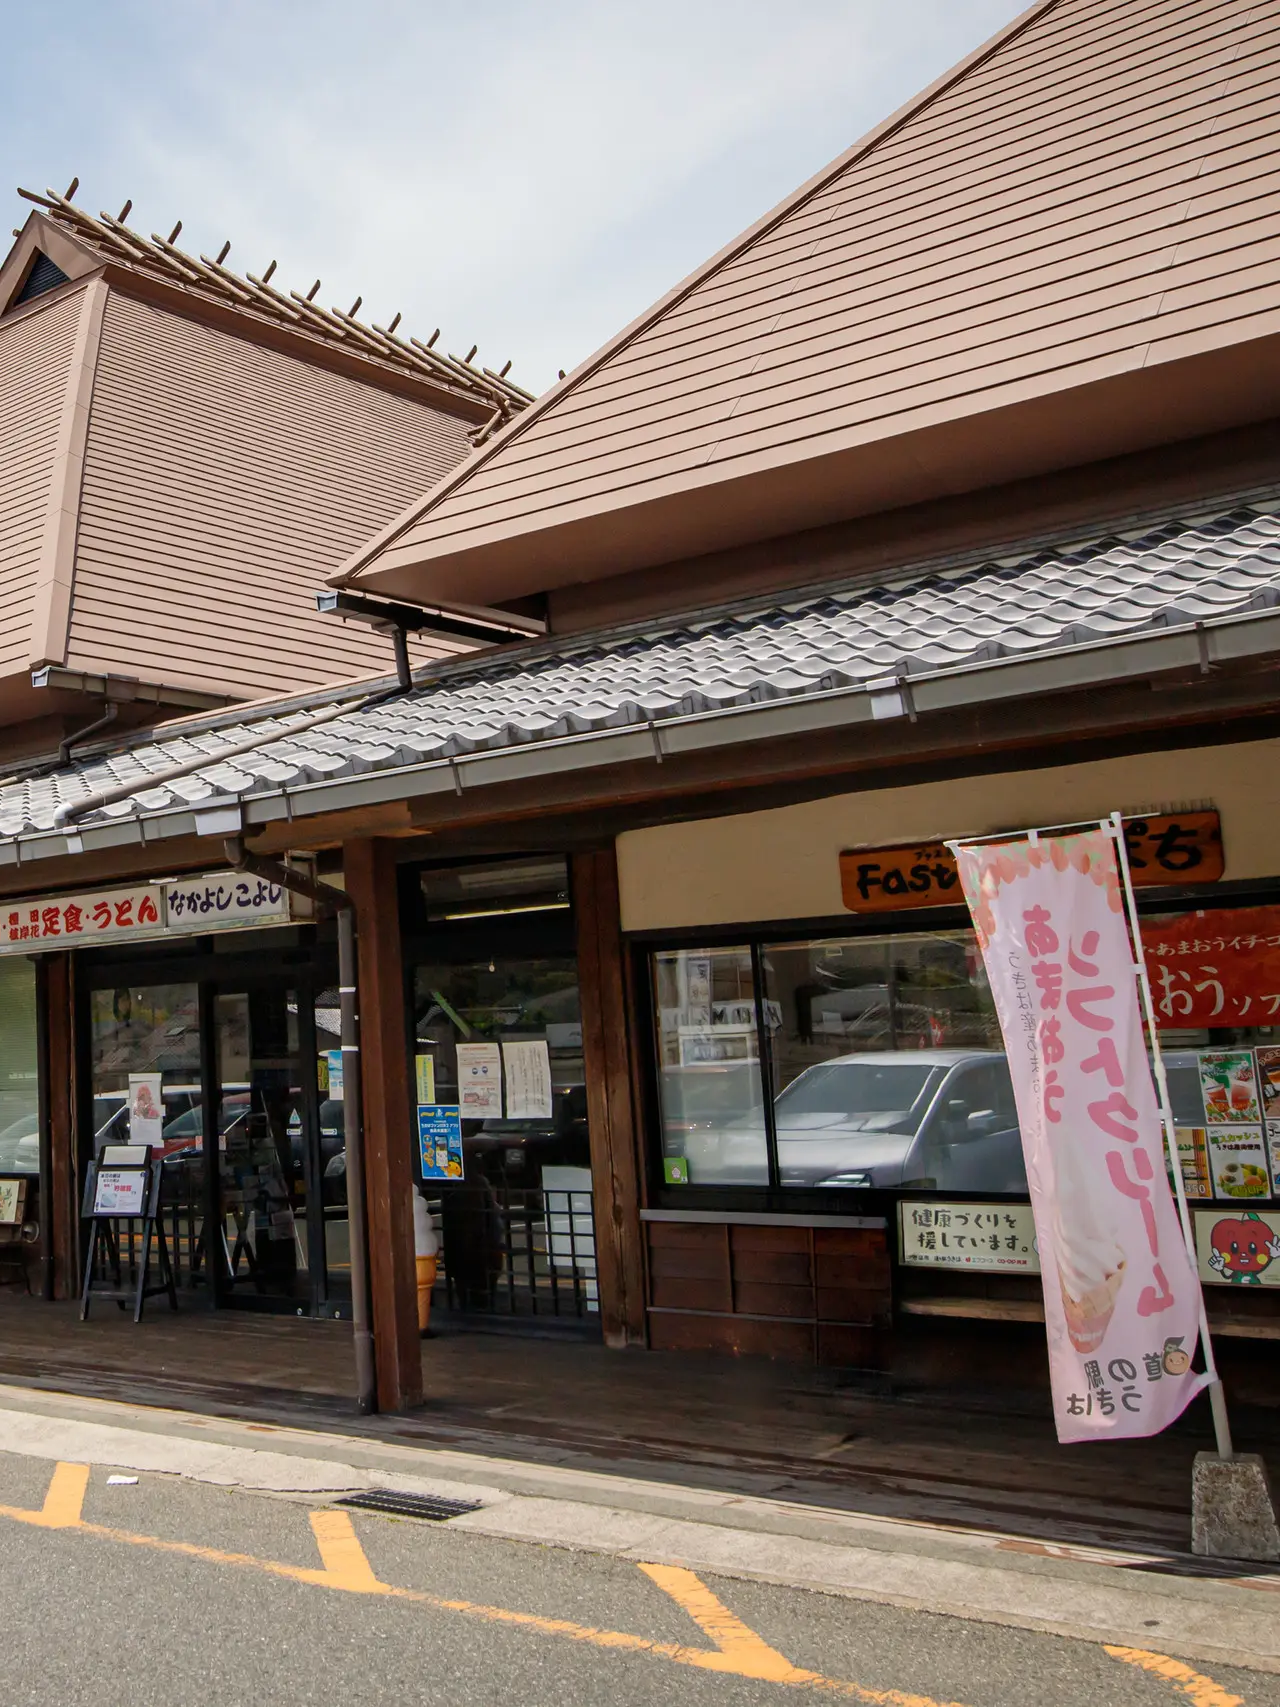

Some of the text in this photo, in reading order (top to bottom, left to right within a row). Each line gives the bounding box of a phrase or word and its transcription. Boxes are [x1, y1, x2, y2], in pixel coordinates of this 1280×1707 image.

[857, 863, 957, 899] Fast
[911, 1208, 1017, 1229] 健康づくりを
